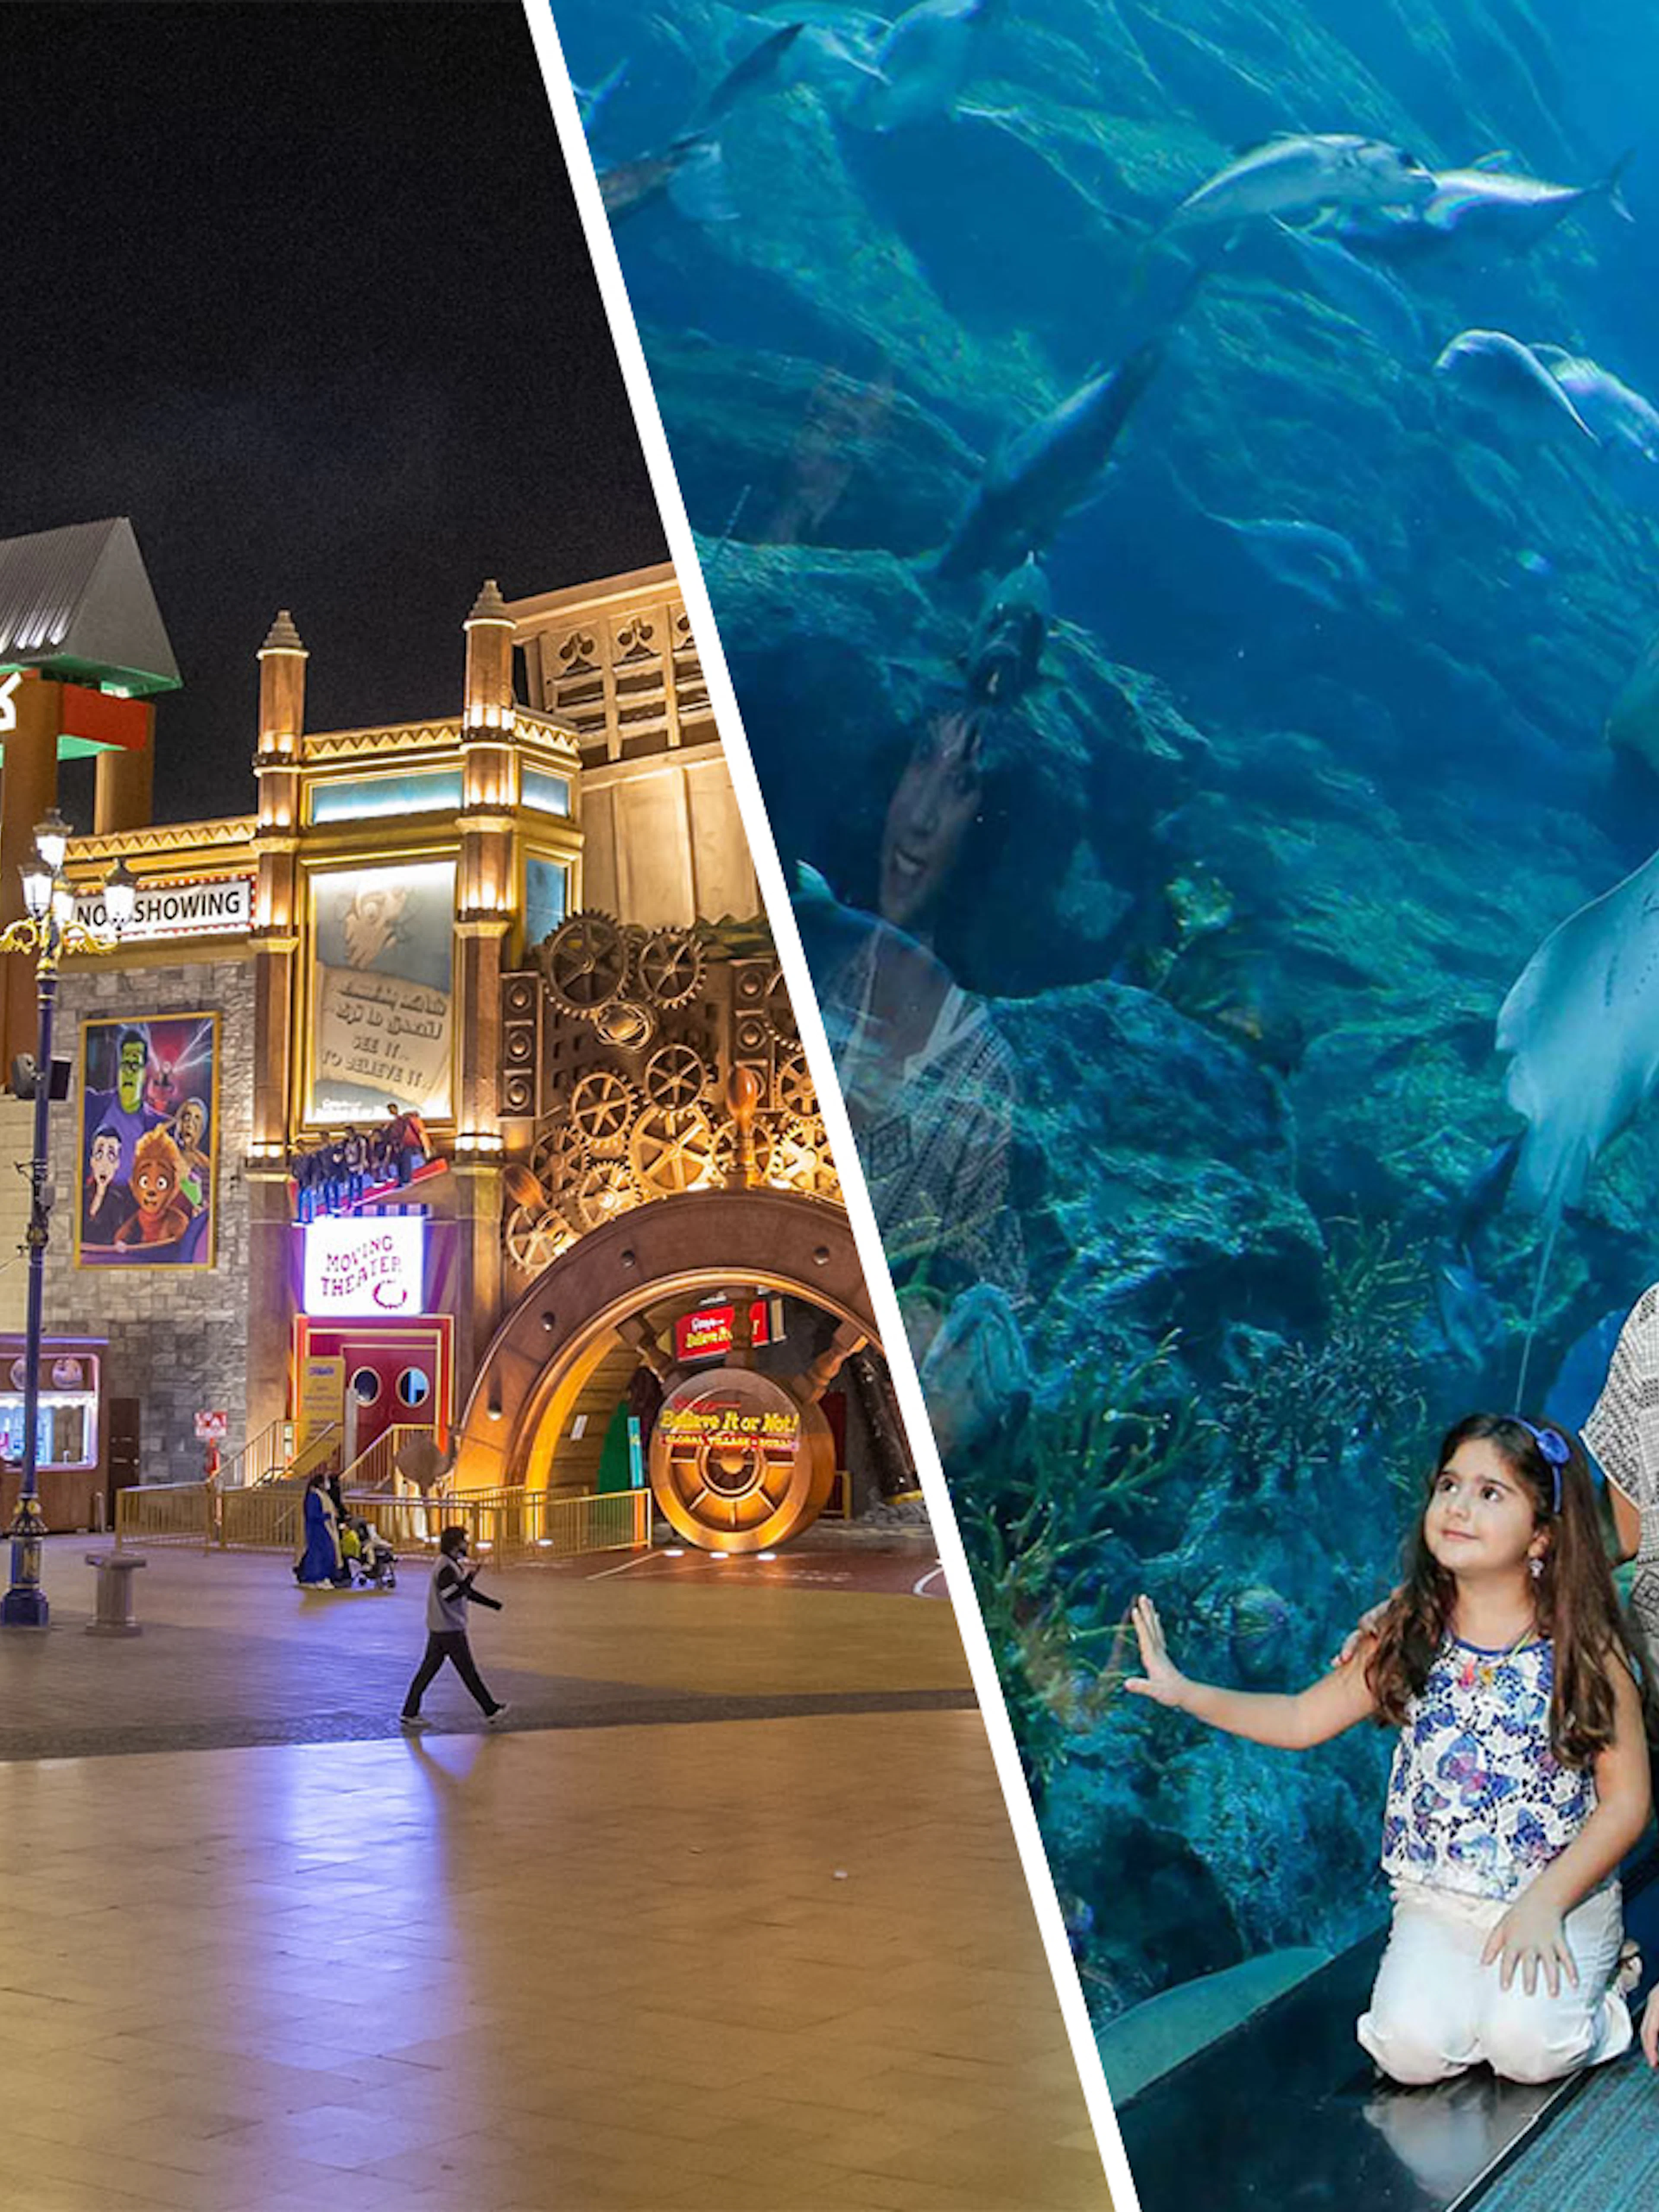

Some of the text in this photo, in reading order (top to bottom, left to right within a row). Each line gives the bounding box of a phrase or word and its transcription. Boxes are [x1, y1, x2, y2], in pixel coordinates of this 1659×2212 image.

[77, 891, 240, 927] NO SHOWING
[346, 1057, 404, 1082] BELIEVE
[327, 1235, 393, 1272] MOVING
[321, 1255, 402, 1297] THEATER
[661, 1408, 721, 1431] Believe
[721, 1409, 740, 1431] It
[740, 1416, 761, 1432] or
